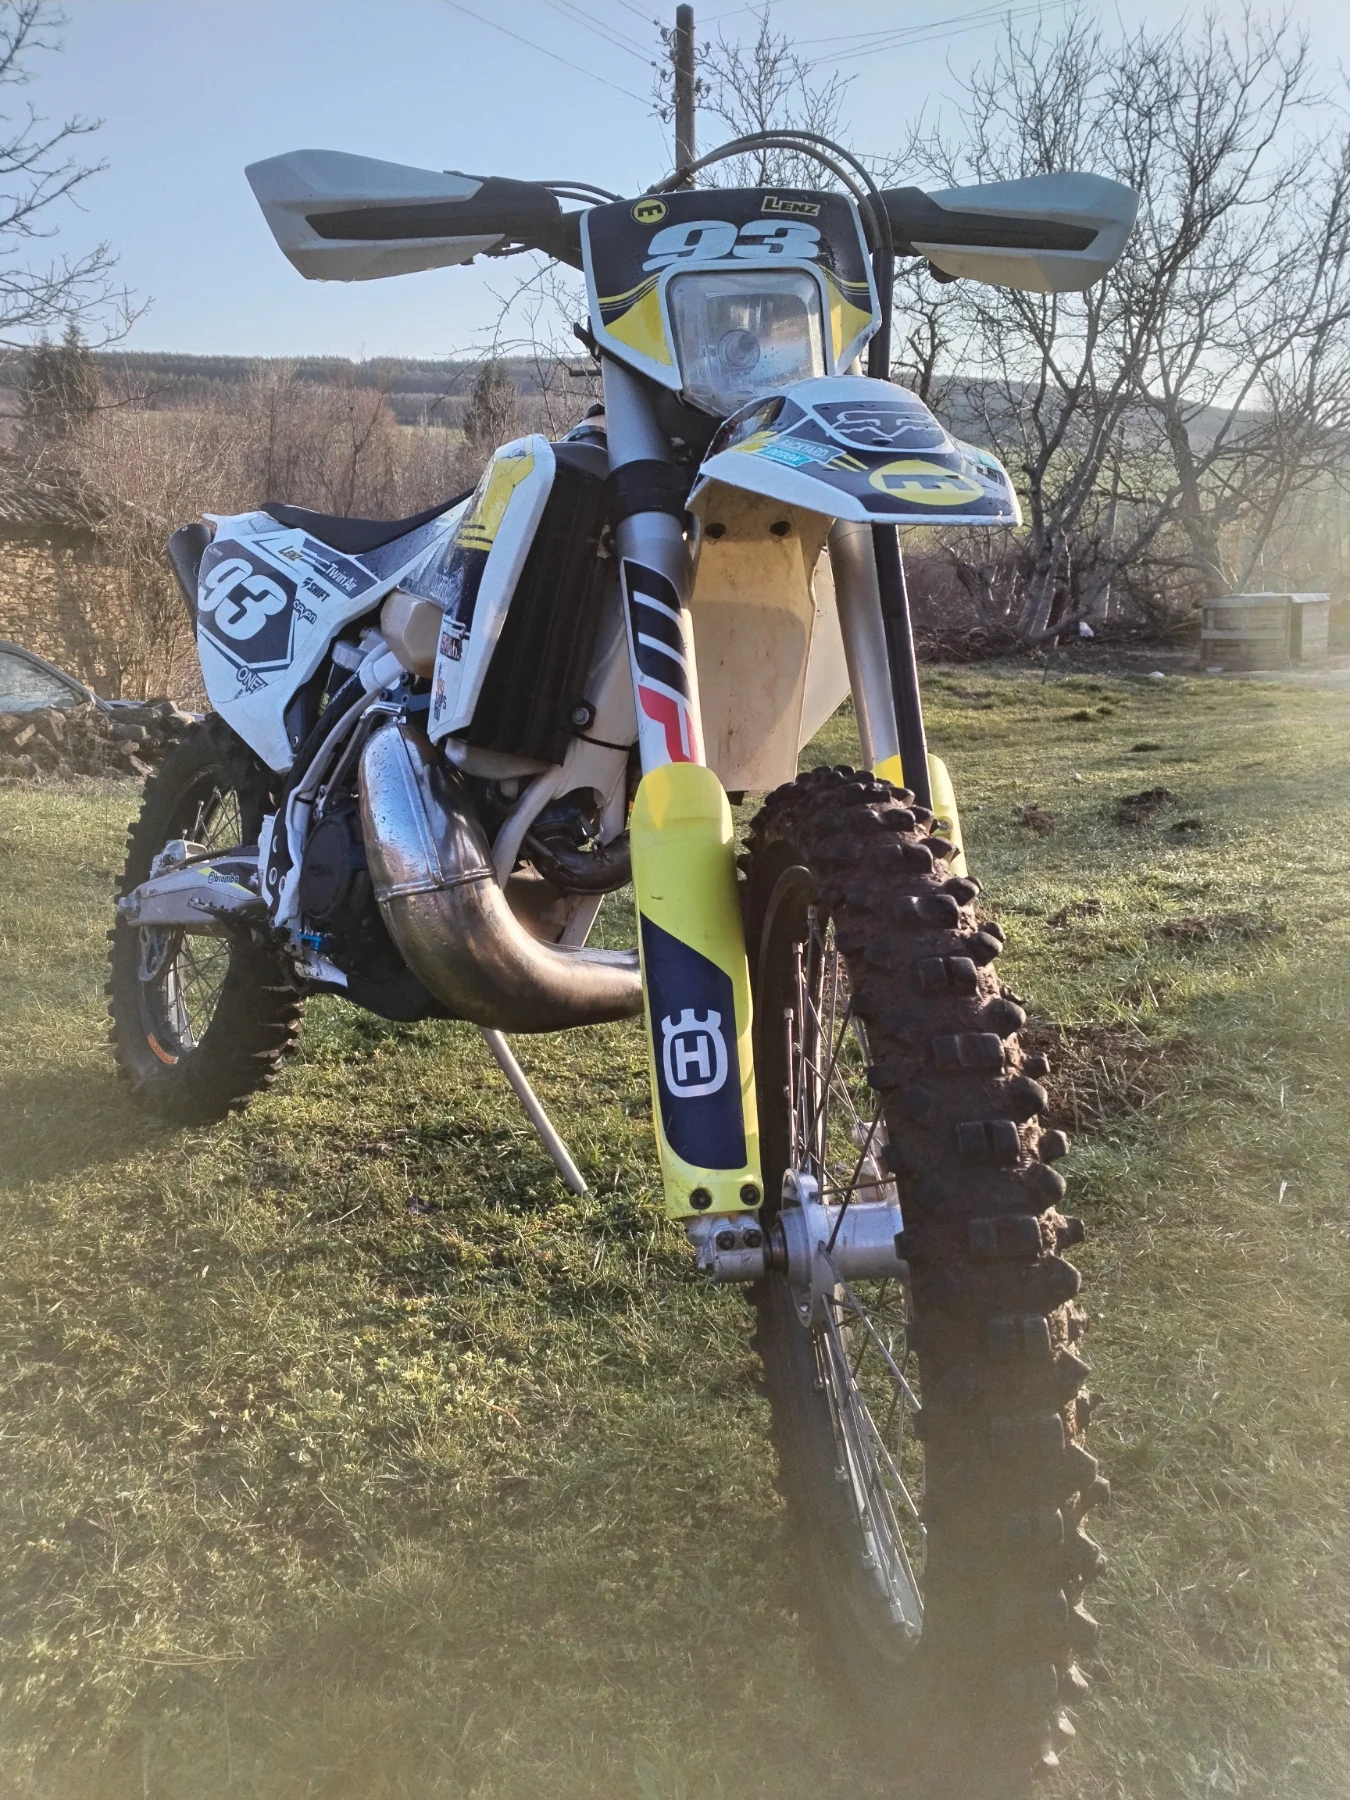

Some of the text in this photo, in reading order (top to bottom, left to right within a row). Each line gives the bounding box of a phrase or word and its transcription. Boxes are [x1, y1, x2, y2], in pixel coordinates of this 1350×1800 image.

[642, 219, 822, 272] 93
[198, 558, 288, 641] 93
[306, 581, 331, 602] SHIFT
[212, 872, 240, 884] brembo
